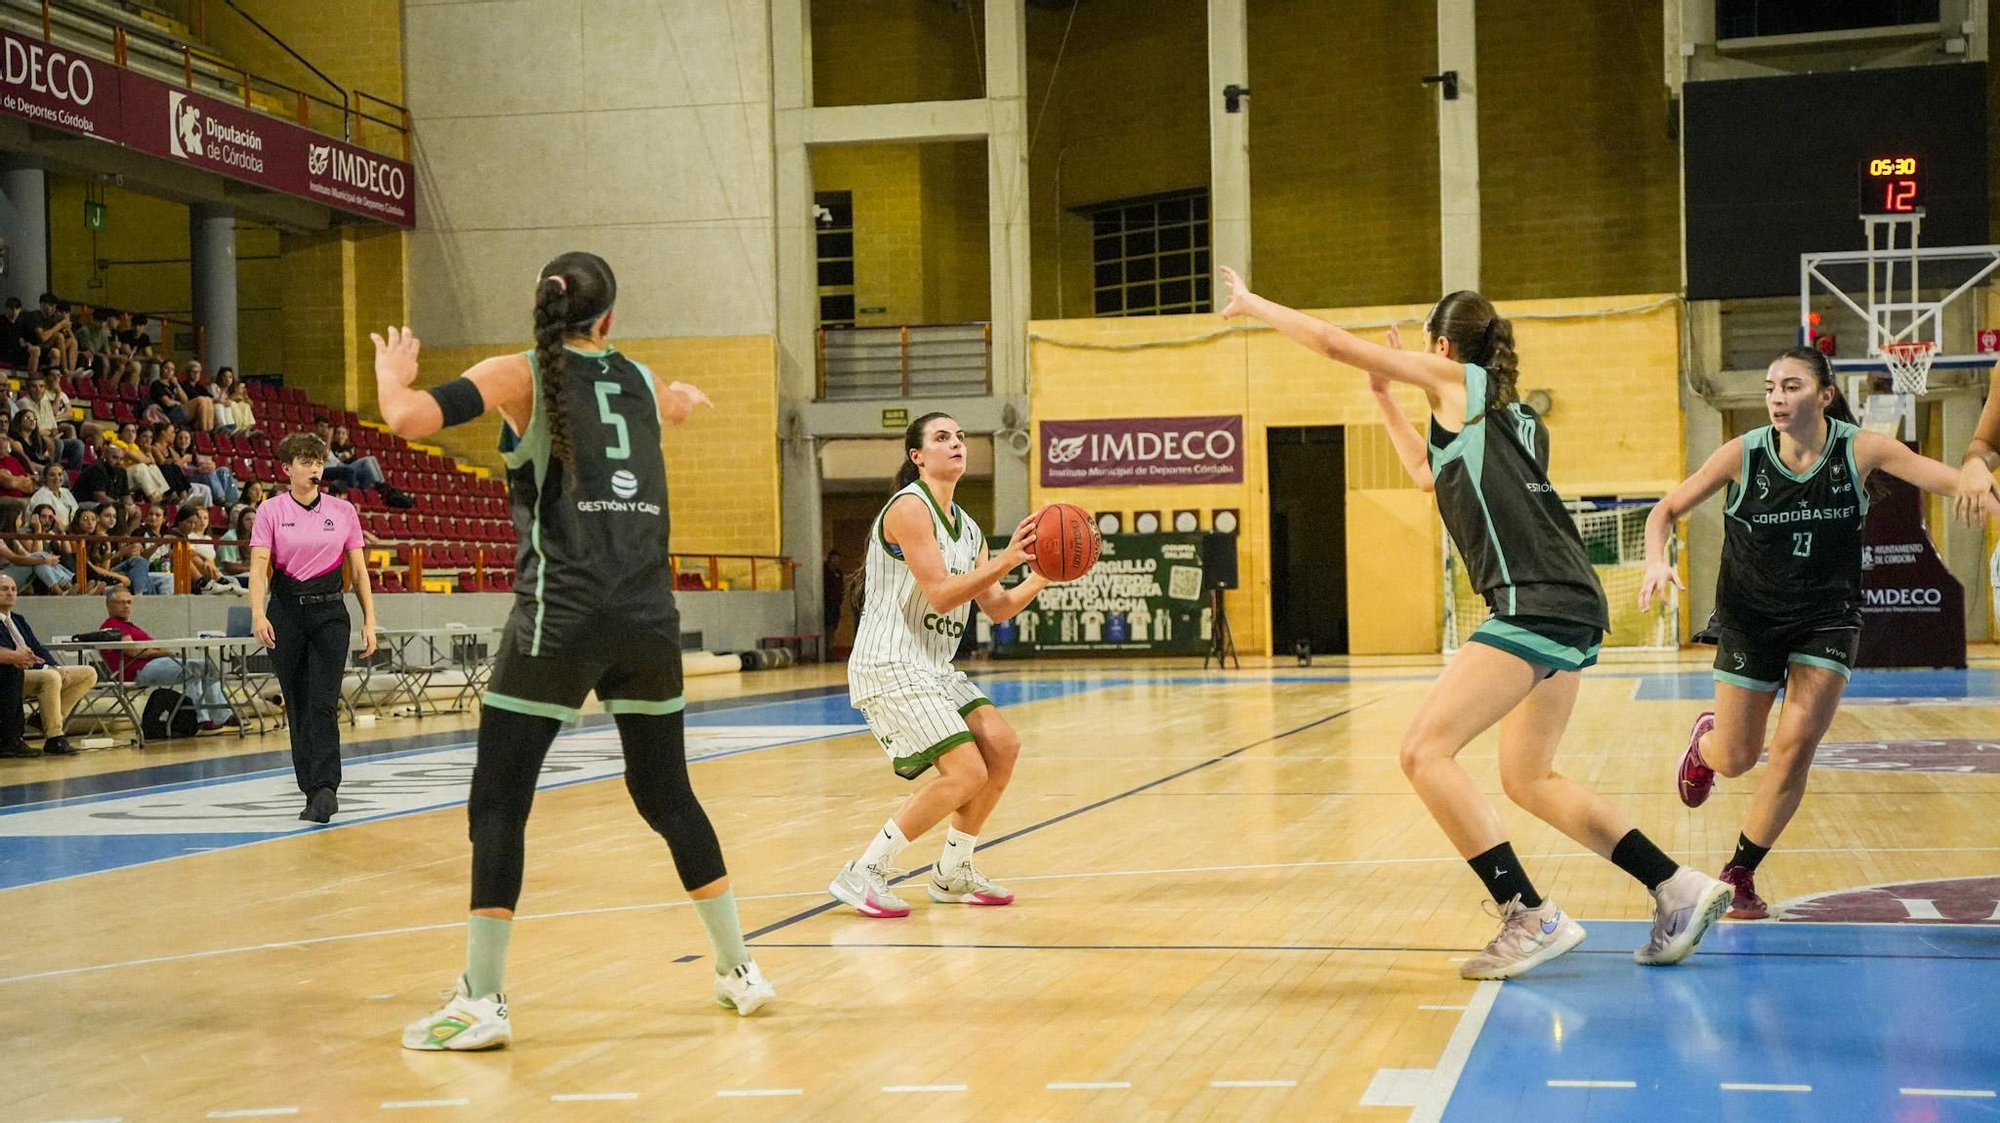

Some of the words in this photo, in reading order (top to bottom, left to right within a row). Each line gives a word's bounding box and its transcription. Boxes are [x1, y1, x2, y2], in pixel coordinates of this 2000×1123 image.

[0, 37, 94, 106] DECO
[4, 94, 17, 109] de
[17, 97, 57, 121] Deportes
[58, 109, 94, 131] Córdoba
[206, 117, 262, 151] Diputación
[207, 141, 221, 160] de
[222, 144, 263, 173] Córdoba
[1870, 158, 1916, 176] 05:30
[332, 147, 405, 200] IMDECO
[1884, 181, 1916, 211] 12
[92, 207, 101, 227] J
[594, 381, 631, 460] 5
[1091, 430, 1236, 462] IMDECO
[1049, 468, 1087, 478] Instituto
[1088, 467, 1134, 477] Municipal
[1135, 466, 1148, 475] de
[1150, 465, 1192, 476] Deportes
[577, 500, 628, 512] GESTIÓN
[628, 502, 636, 512] Y
[1752, 506, 1856, 524] CORDOBASKET
[1792, 531, 1813, 558] 23
[1112, 582, 1162, 598] FUERA
[1861, 588, 1942, 605] MDECO
[1082, 597, 1149, 611] CANCHA
